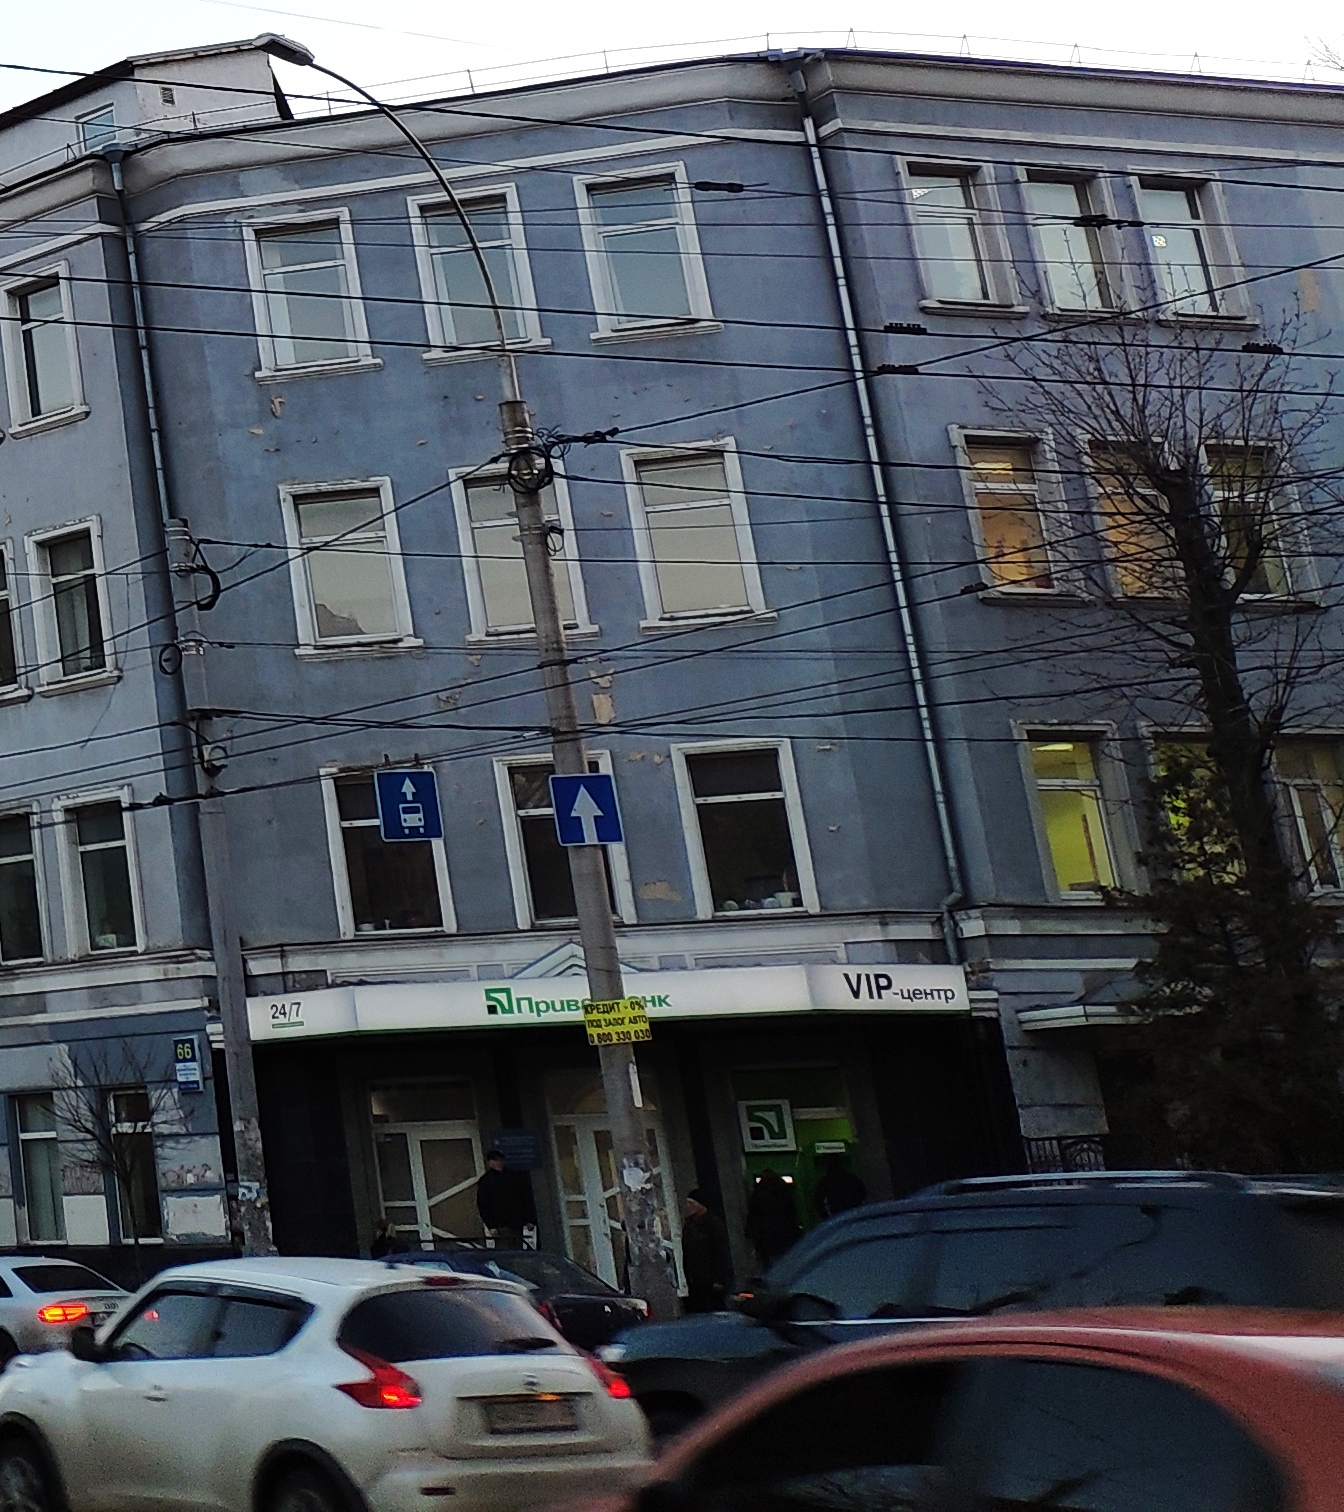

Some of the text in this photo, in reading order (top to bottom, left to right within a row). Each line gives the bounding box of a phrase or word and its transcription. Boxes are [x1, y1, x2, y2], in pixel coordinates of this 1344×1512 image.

[842, 972, 956, 1004] VIP-центр
[270, 1001, 302, 1020] 24/7
[584, 1001, 621, 1015] КРЕДИТ
[629, 1000, 645, 1011] 0%
[587, 1014, 648, 1029] ПОД ЗАЛОГ АВТО
[615, 1030, 632, 1042] 330
[633, 1028, 651, 1040] 030
[176, 1042, 192, 1060] 66
